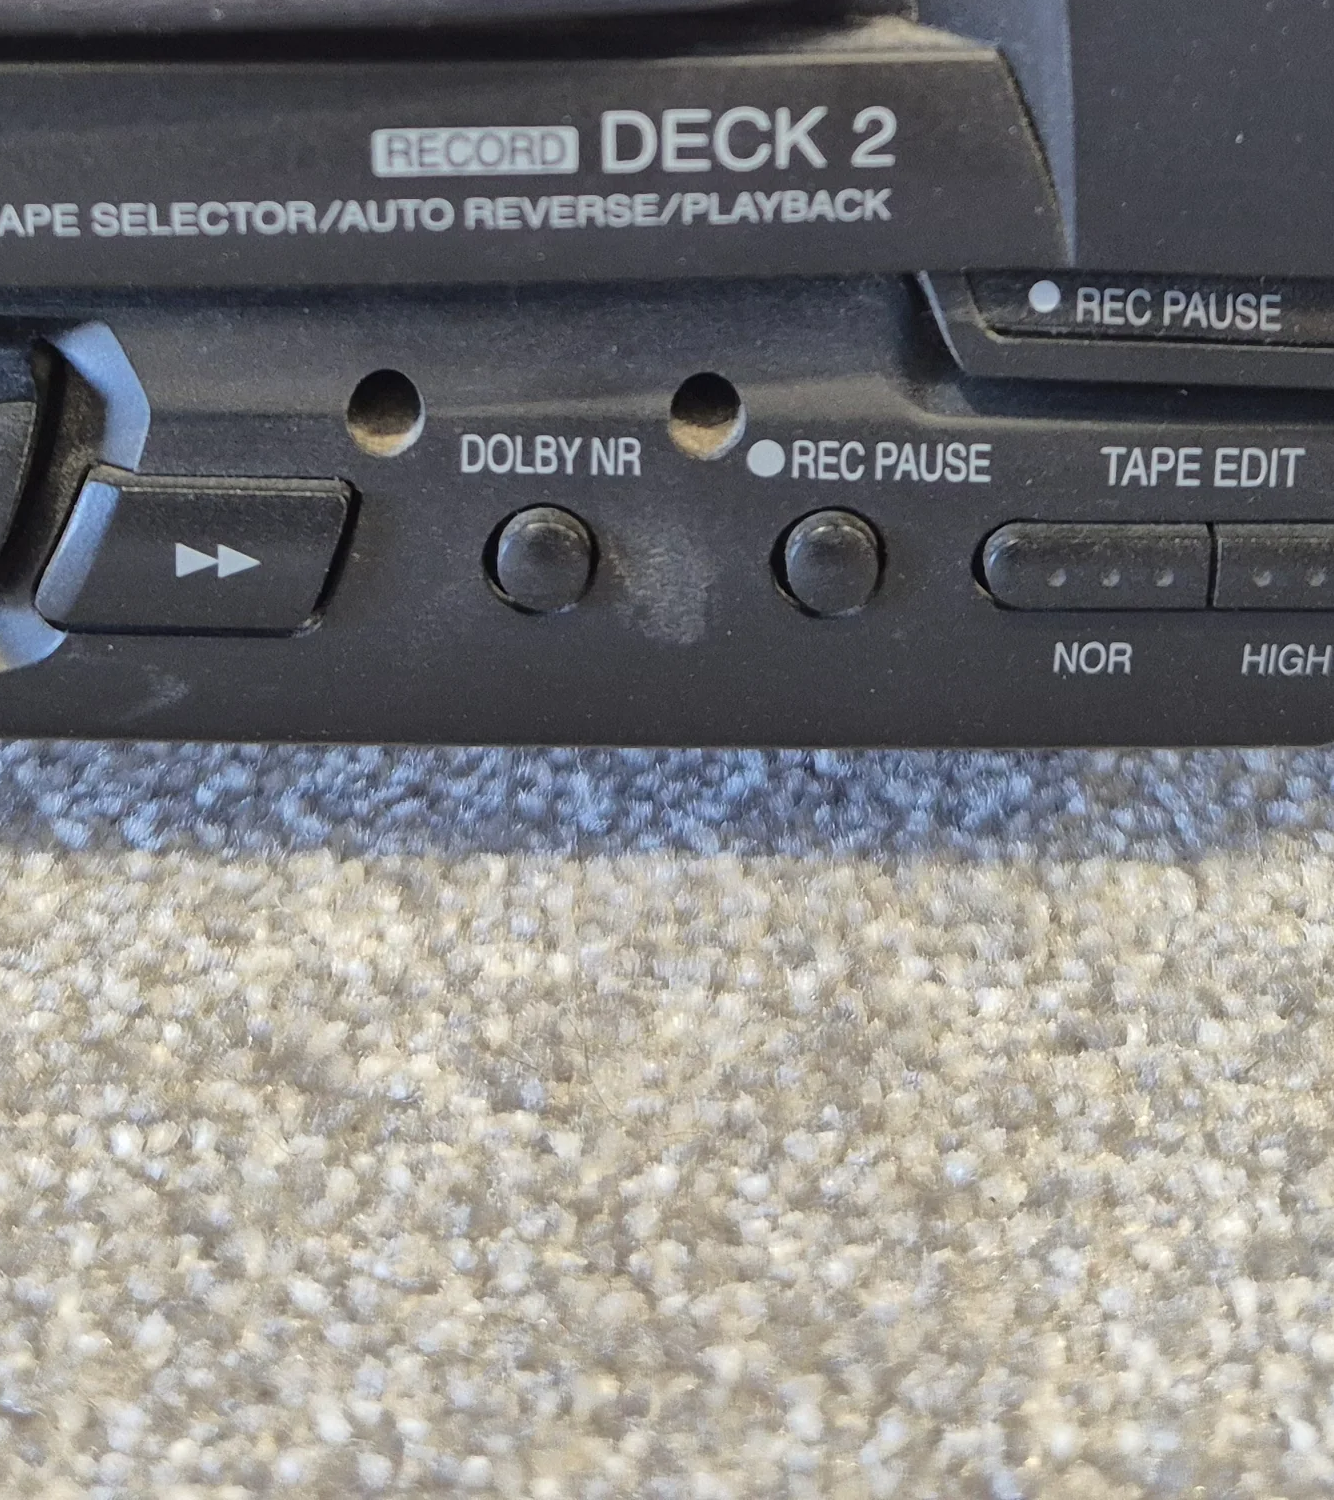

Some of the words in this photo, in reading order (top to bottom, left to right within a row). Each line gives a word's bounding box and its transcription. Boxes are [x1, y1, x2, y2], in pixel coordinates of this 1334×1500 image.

[384, 131, 567, 170] RECORD
[601, 105, 827, 174] DECK
[850, 105, 897, 168] 2
[90, 197, 455, 237] SELECTOR/AUTO
[463, 187, 892, 230] REVERSE/PLAYBACK
[1075, 287, 1152, 327] REC
[1162, 290, 1283, 333] PAUSE
[460, 433, 581, 475] DOLBY
[590, 436, 642, 477] NR
[791, 439, 866, 482] REC
[874, 441, 992, 483] PAUSE
[1100, 446, 1203, 487] TAPE
[1213, 447, 1306, 488] EDIT
[1053, 641, 1133, 674] NOR
[1241, 643, 1333, 676] HIGH
